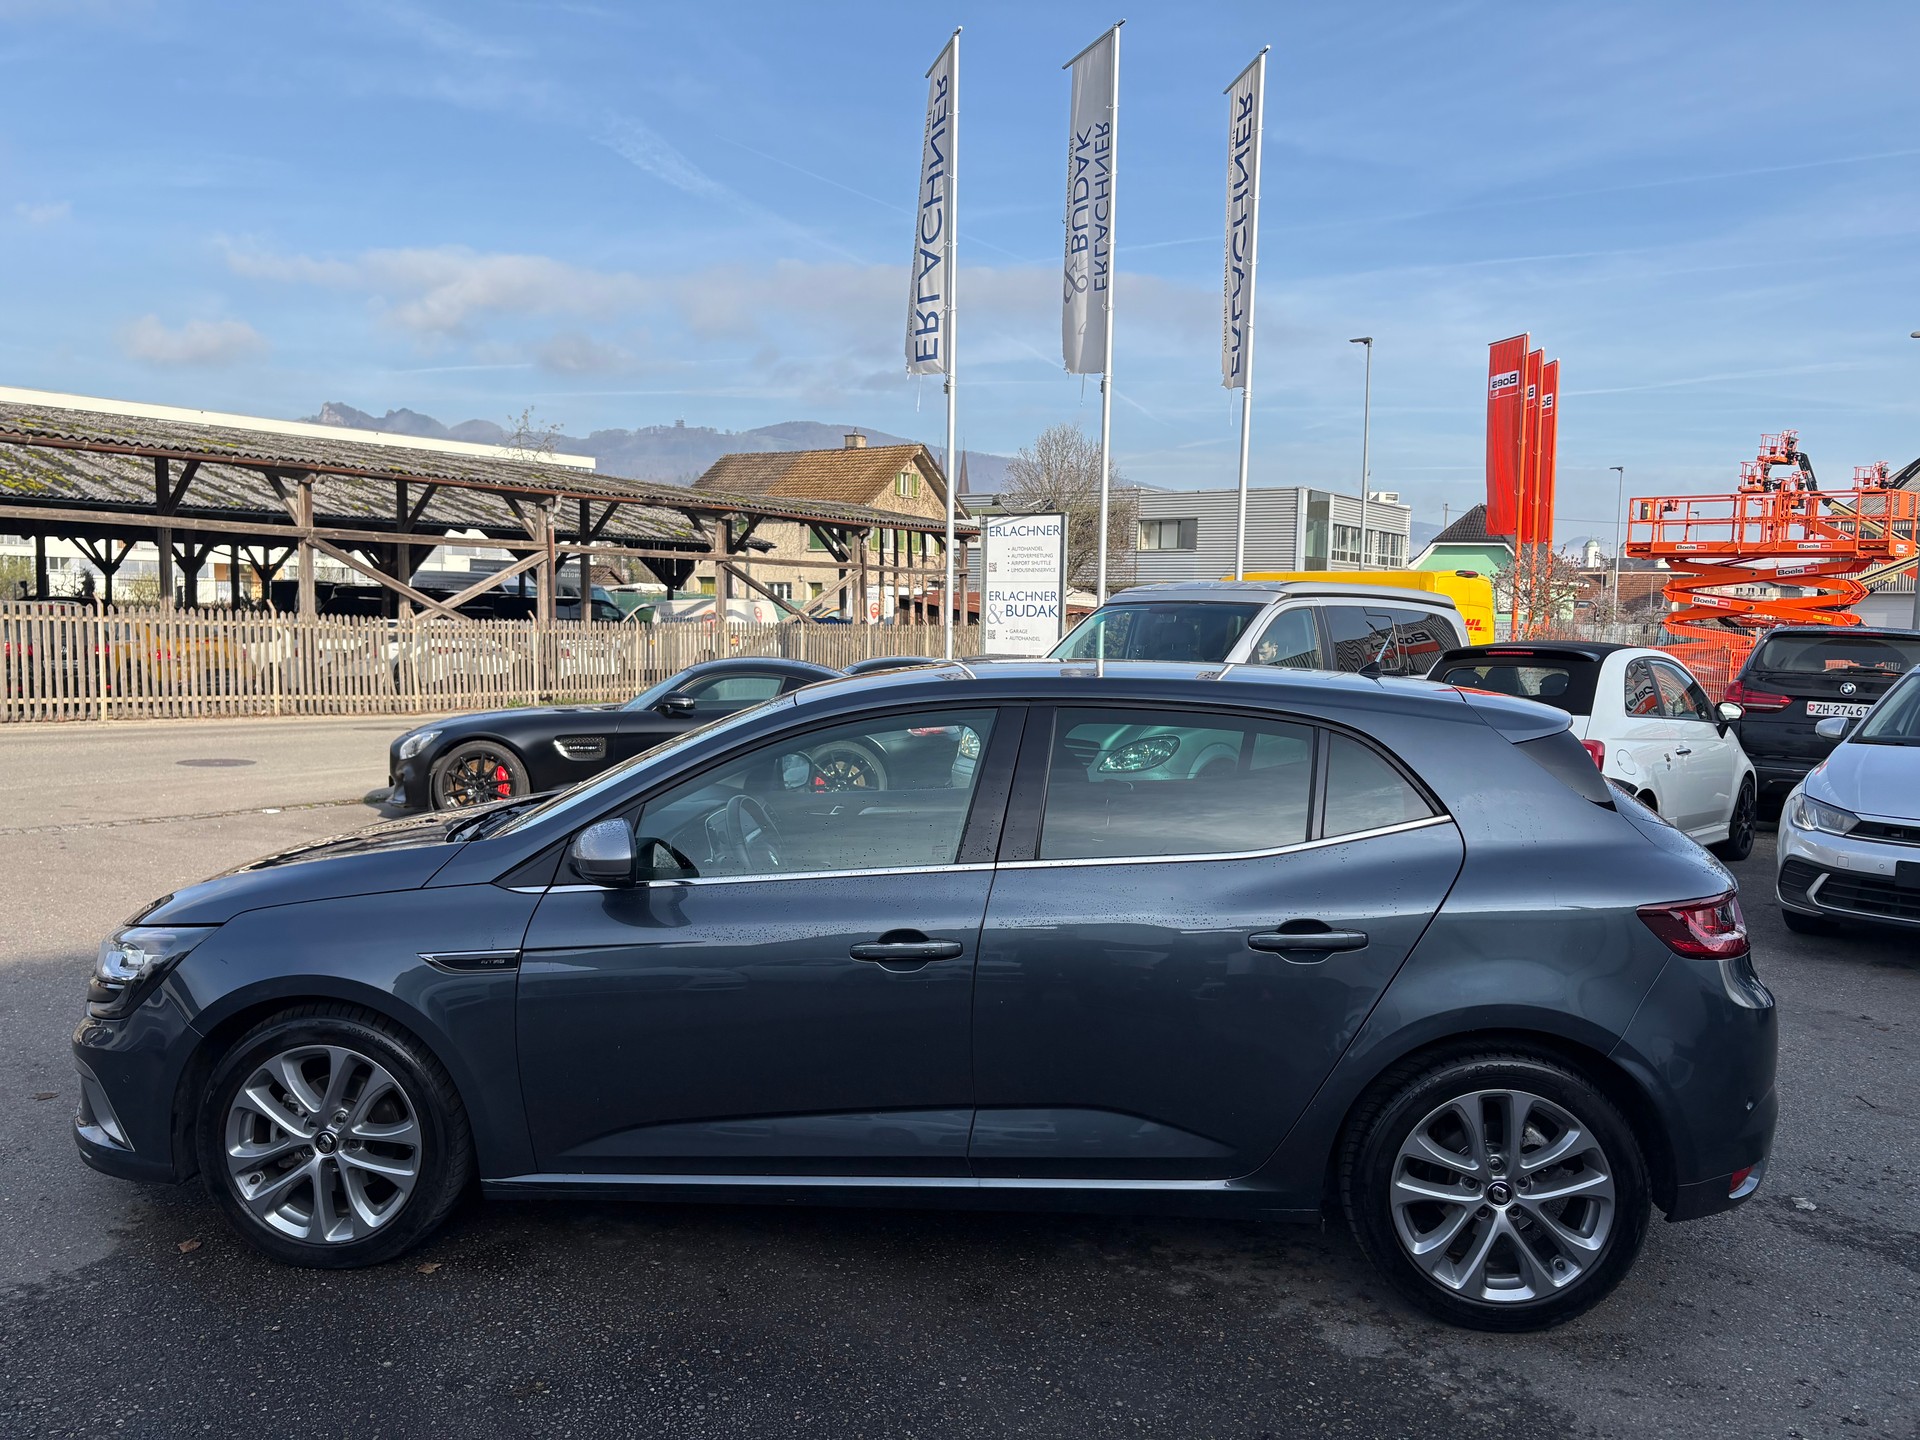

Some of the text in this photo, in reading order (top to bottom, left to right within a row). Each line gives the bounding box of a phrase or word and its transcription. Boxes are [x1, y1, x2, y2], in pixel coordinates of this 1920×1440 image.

[989, 525, 1061, 537] ERLACHNER
[1777, 568, 1804, 576] Boels
[988, 590, 1058, 602] ERLACHNER
[1693, 596, 1717, 605] Boels
[987, 603, 1058, 625] & BUDAK
